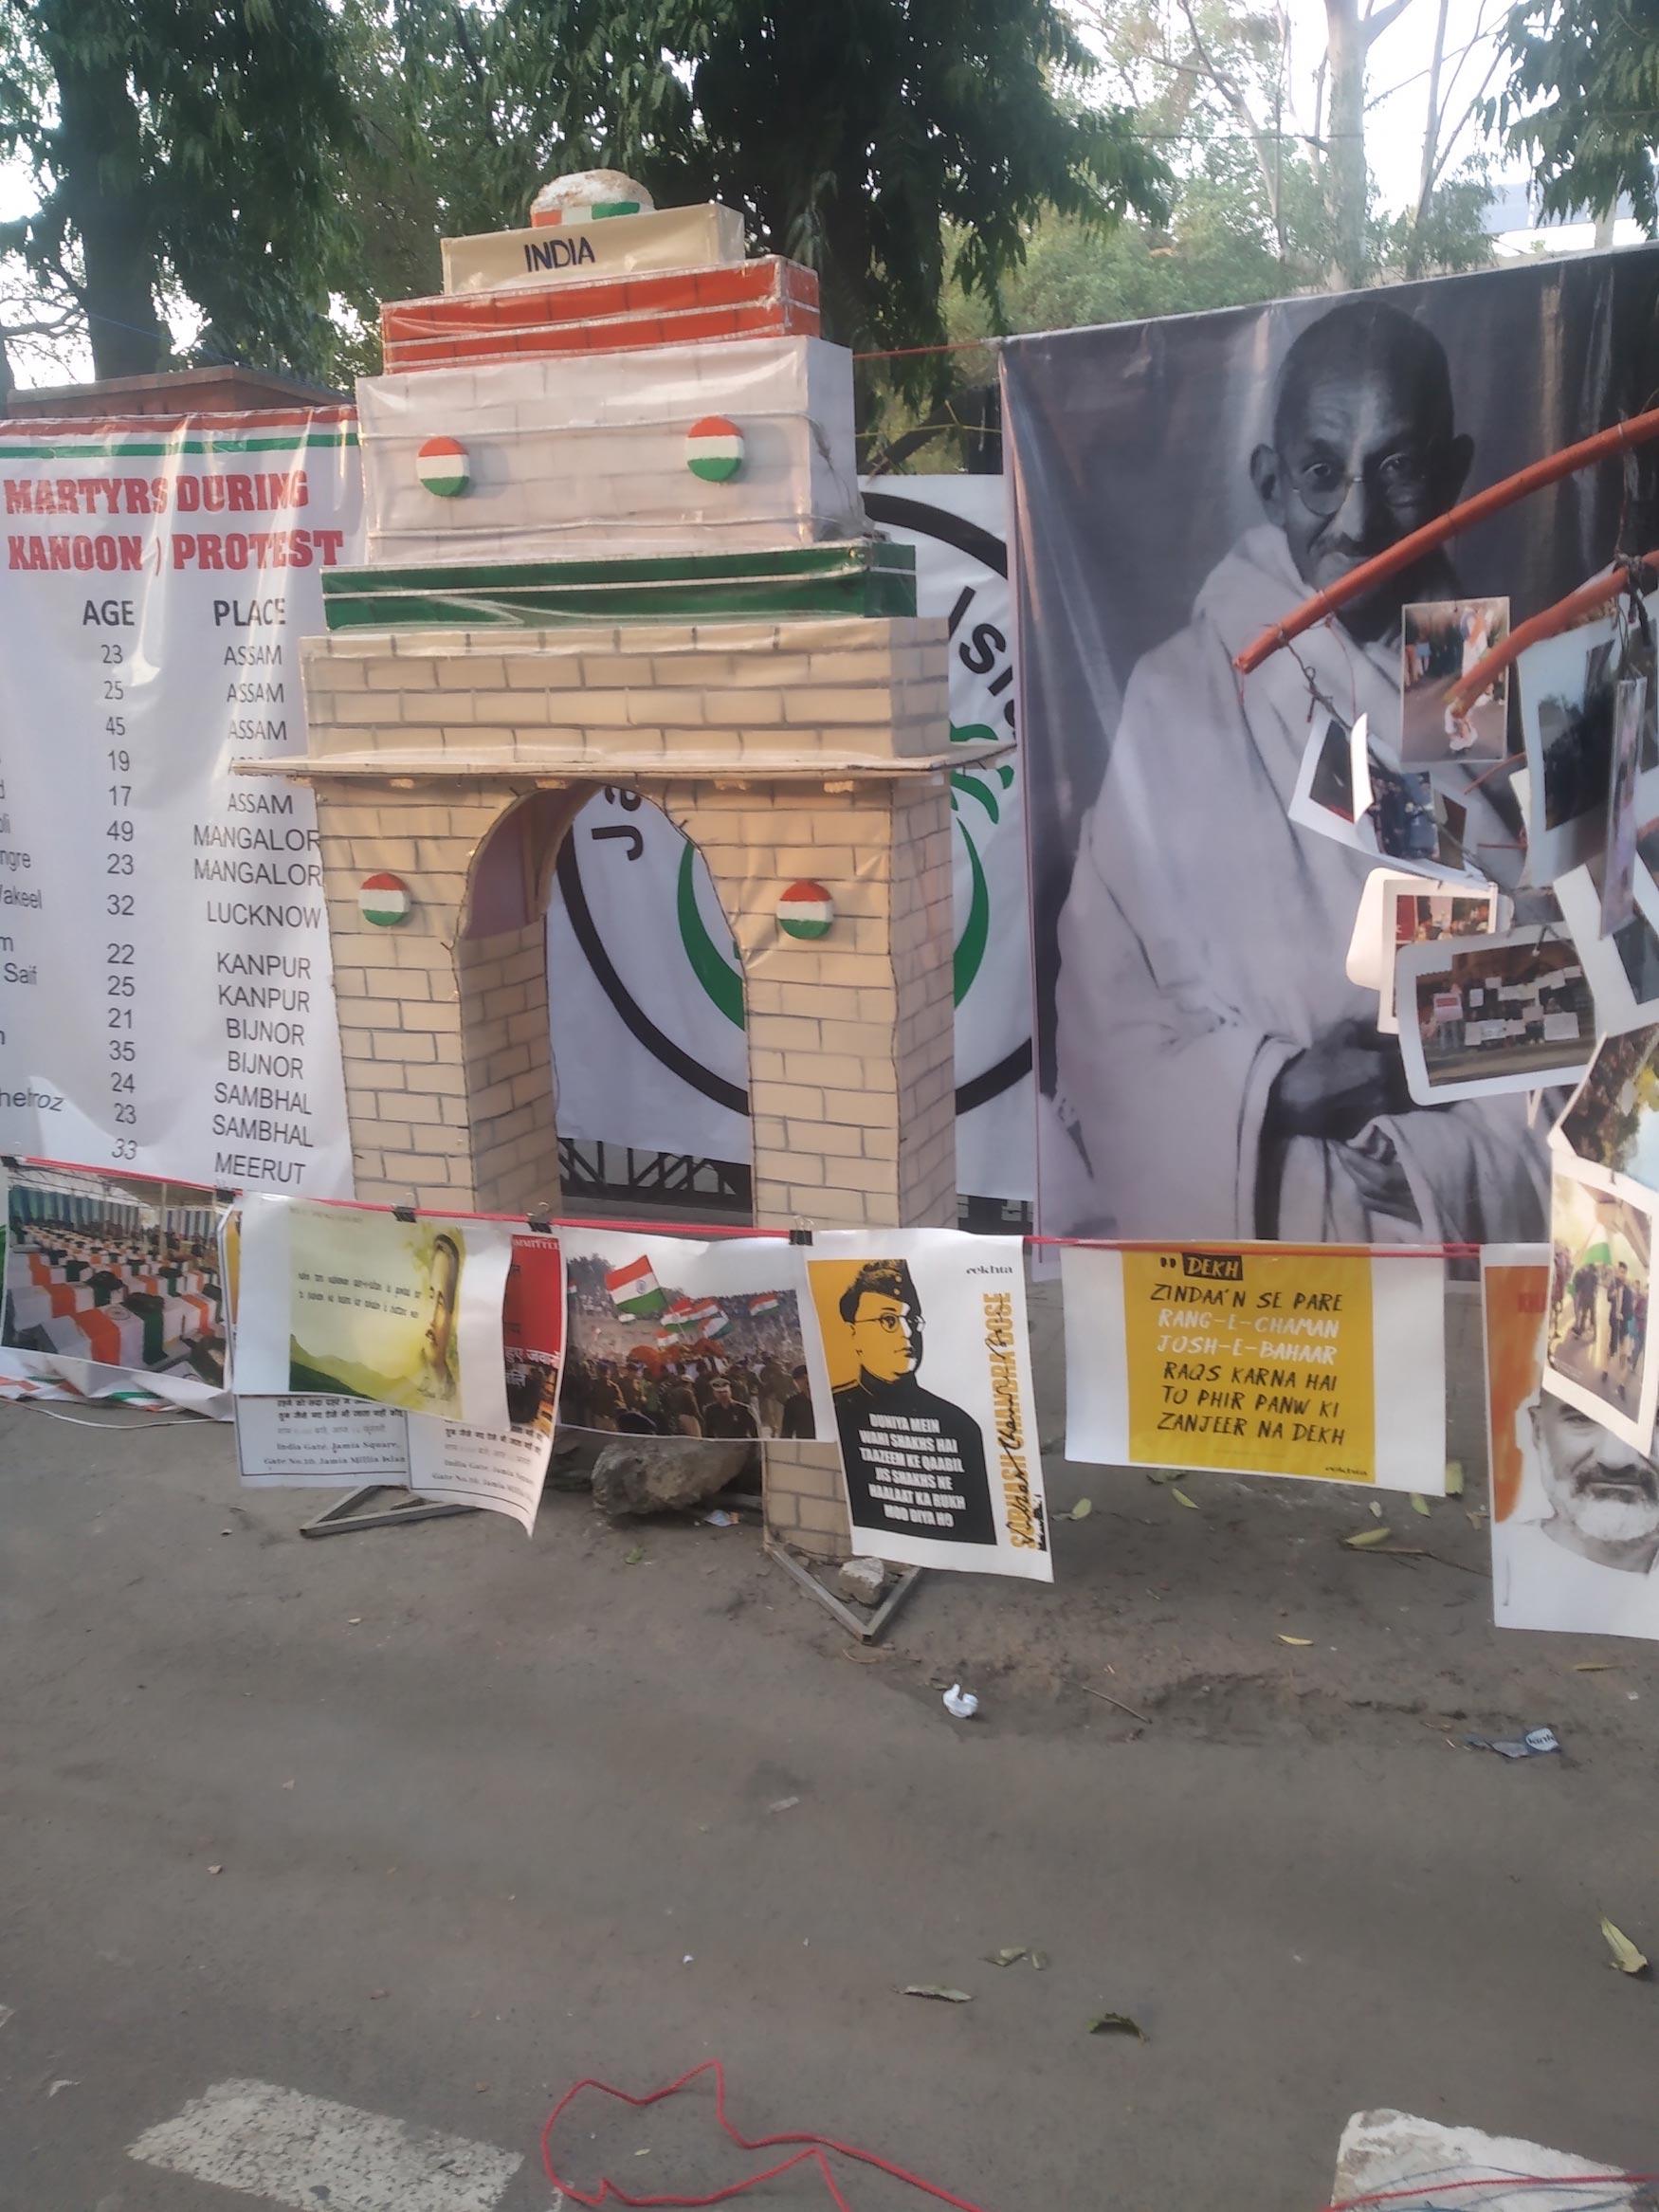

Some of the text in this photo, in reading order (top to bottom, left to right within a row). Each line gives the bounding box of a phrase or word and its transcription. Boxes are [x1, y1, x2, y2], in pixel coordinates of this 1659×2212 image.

[524, 236, 595, 272] INDIA
[4, 469, 309, 515] MARTYRS DURING
[8, 535, 143, 571] KANOON
[172, 529, 344, 570] PROTEST
[82, 598, 286, 627] AGE PLACE
[100, 644, 123, 665] 23
[224, 644, 283, 666] ASSAM
[103, 680, 124, 700] 25
[227, 682, 284, 704] ASSAM
[105, 717, 126, 737] 45
[228, 719, 287, 740] ASSAM
[107, 749, 131, 772] 19
[108, 785, 132, 807] 17
[228, 793, 294, 815] ASSAM
[106, 819, 135, 842] 49
[106, 852, 135, 876] 23
[106, 893, 136, 916] 32
[207, 900, 321, 929] LUCKNOW
[106, 942, 136, 965] 22
[217, 951, 311, 979] KANPUR
[107, 975, 136, 996] 25
[218, 983, 311, 1014] KANPUR
[108, 1007, 133, 1029] 21
[227, 1017, 305, 1046] BIJNOR
[108, 1039, 136, 1061] 35
[228, 1050, 303, 1080] BIJNOR
[111, 1071, 136, 1093] 24
[213, 1081, 312, 1115] SAMBHAL
[115, 1102, 137, 1124] 23
[212, 1113, 314, 1148] SAMBHAL
[111, 1137, 138, 1161] 33
[214, 1151, 306, 1184] MEERUT
[1188, 1256, 1240, 1278] DEKH
[1256, 1291, 1283, 1309] SE
[1293, 1292, 1343, 1311] PARE
[1157, 1307, 1340, 1339] RANG-E-CHAMAN
[1156, 1334, 1339, 1366] JOSH-E-BAHAAR
[1162, 1362, 1339, 1392] RAQS KARNA HAI
[1161, 1385, 1340, 1418] TO PHIR PANW KI
[1157, 1412, 1346, 1446] ZANJEER NA DEKH
